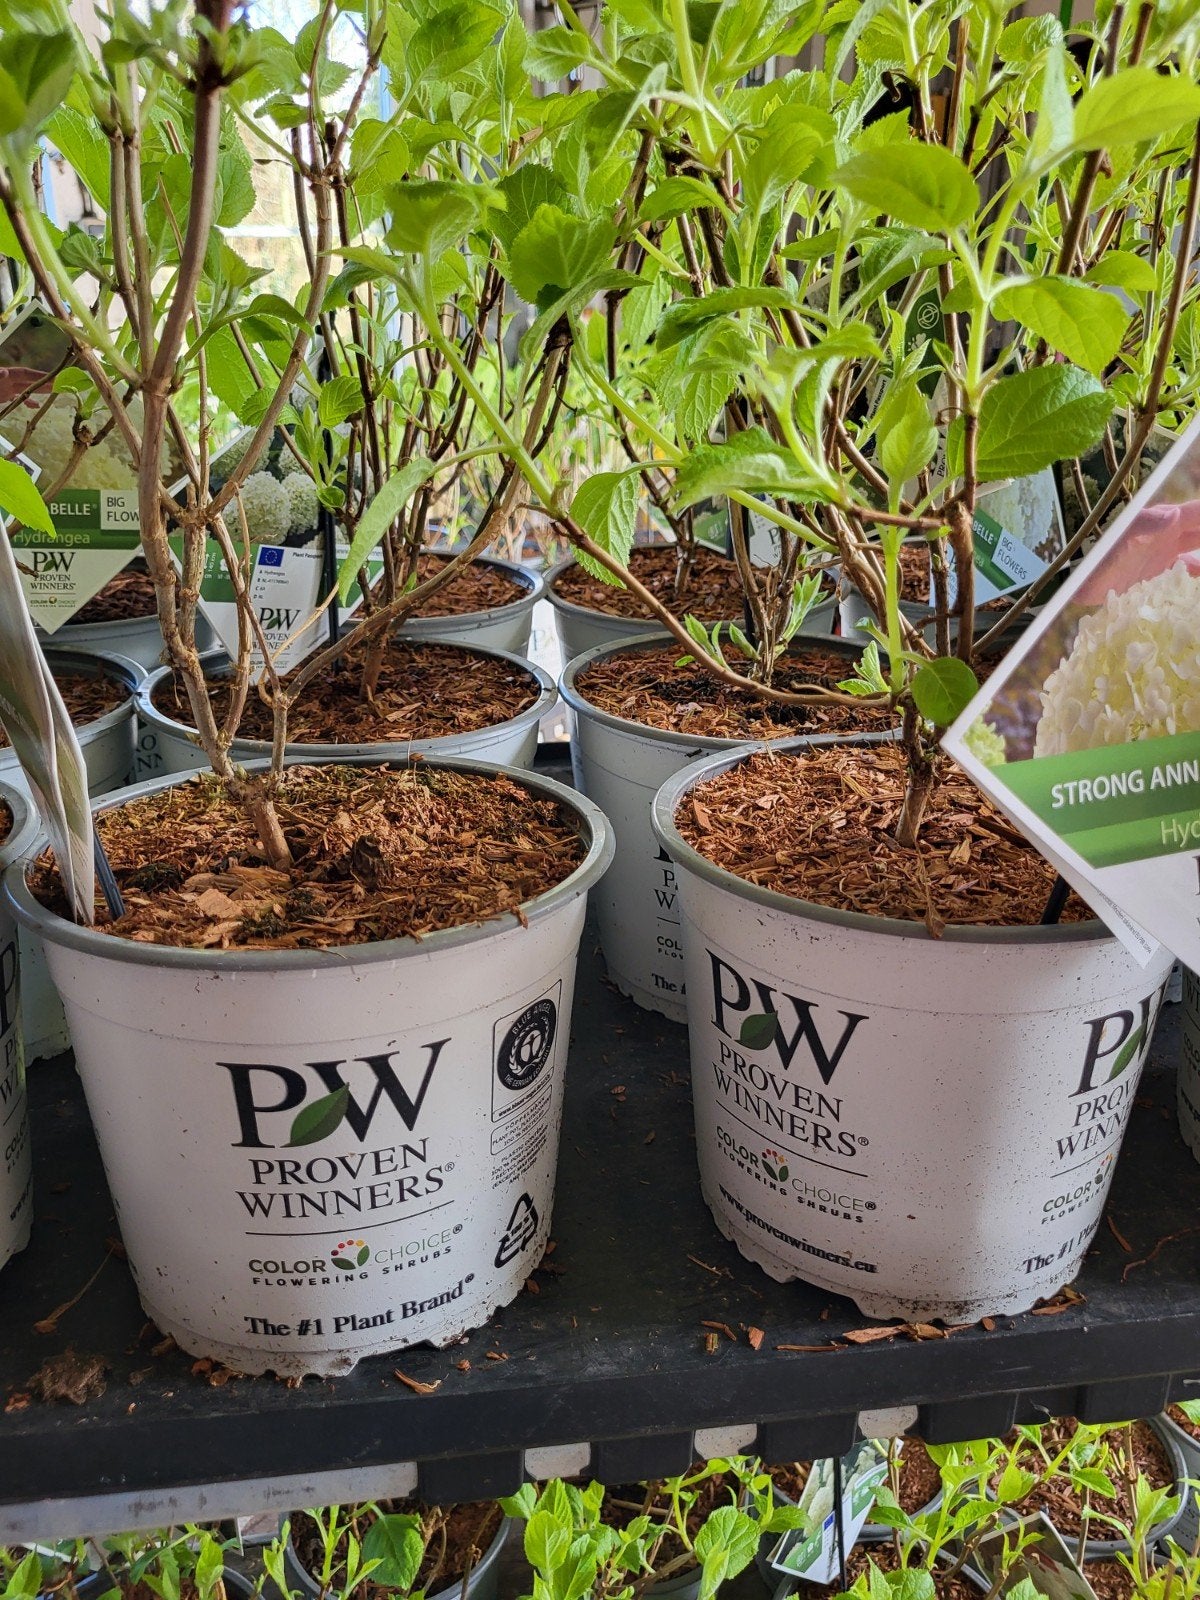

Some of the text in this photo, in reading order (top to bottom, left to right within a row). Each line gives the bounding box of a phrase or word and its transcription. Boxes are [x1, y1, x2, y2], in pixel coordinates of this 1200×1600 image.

[107, 497, 125, 507] BIG
[107, 511, 140, 522] FLOW
[32, 551, 76, 572] PW
[998, 548, 1029, 580] FLOWERS
[1001, 537, 1013, 552] BIG
[260, 607, 301, 631] PW
[1051, 769, 1145, 809] STRONG
[657, 936, 682, 951] COL
[652, 973, 677, 993] The
[511, 1010, 532, 1035] BLUE
[705, 948, 870, 1085] PW
[216, 1037, 452, 1148] PW
[718, 1039, 843, 1123] PROVEN
[711, 1062, 870, 1157] WINNERS®
[248, 1137, 430, 1185] PROVEN
[716, 1126, 877, 1212] COLOR CHOICE®
[235, 1161, 455, 1219] WINNERS®
[717, 1141, 864, 1224] FLOWERING SHRUBS
[1042, 1181, 1092, 1213] COLOR
[248, 1223, 463, 1275] COLOR CHOICE®
[718, 1182, 878, 1275] www.provenwinners.eu
[253, 1245, 452, 1287] FLOWERING SHRUBS
[1022, 1252, 1055, 1275] The
[1057, 1237, 1074, 1260] #1
[244, 1272, 476, 1336] The #1 Plant Brand®
